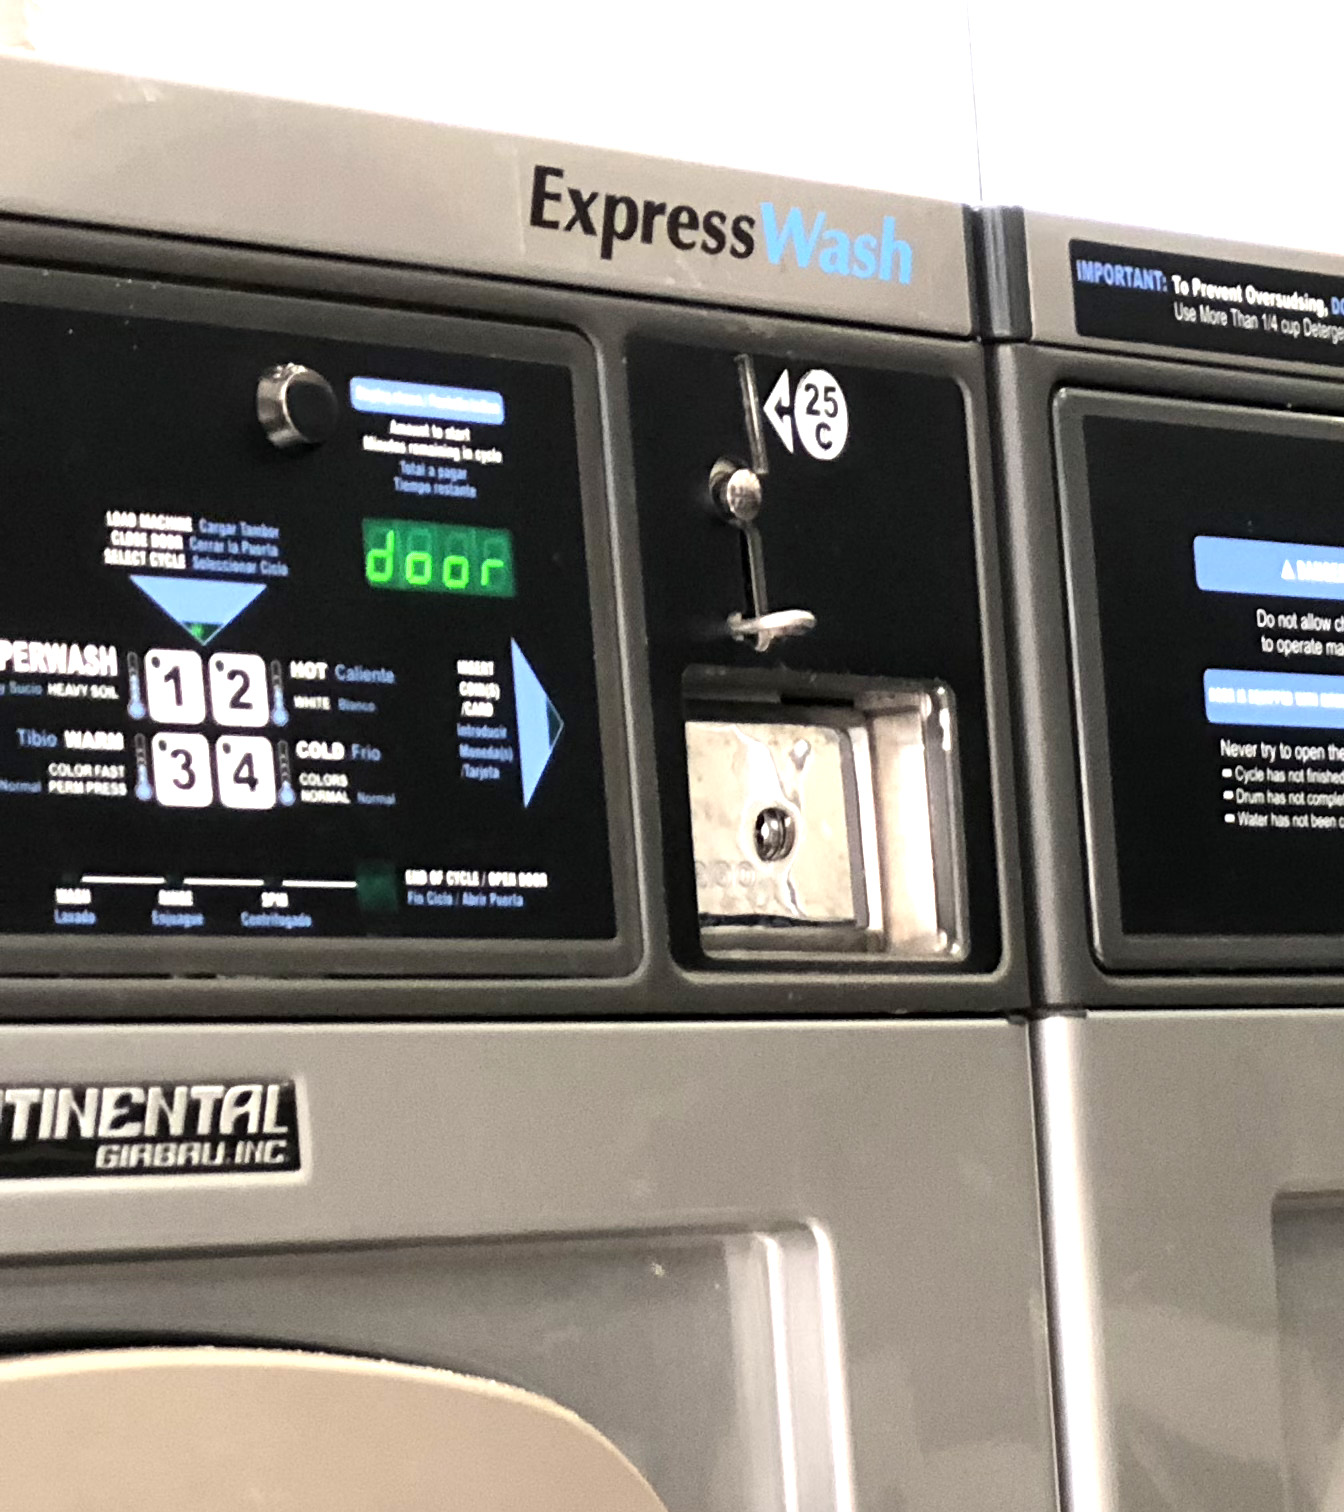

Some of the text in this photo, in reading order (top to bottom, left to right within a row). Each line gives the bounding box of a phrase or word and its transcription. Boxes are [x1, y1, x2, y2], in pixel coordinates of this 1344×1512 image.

[529, 164, 912, 285] ExpressWash
[1076, 259, 1168, 293] IMPORTANT:
[1171, 274, 1189, 296] To
[1191, 277, 1242, 304] Prevent
[1173, 301, 1197, 322] Use
[1200, 304, 1228, 327] More
[1230, 307, 1258, 330] Than
[1281, 317, 1300, 339] cup
[804, 383, 838, 418] 25
[815, 421, 833, 451] C
[149, 550, 187, 569] CYCLE
[365, 529, 505, 589] door
[1256, 608, 1276, 628] Do
[1277, 612, 1298, 630] not
[1300, 613, 1332, 631] allow
[1261, 634, 1275, 652] to
[1276, 638, 1324, 657] operate
[290, 660, 397, 685] HOT Caliente
[47, 682, 88, 699] HEAVY
[164, 665, 184, 707] 1
[226, 669, 253, 710] 2
[293, 695, 332, 712] WHITE
[16, 728, 126, 752] Tibio WARM
[295, 740, 346, 762] COLD
[1220, 738, 1258, 758] Never
[1260, 741, 1277, 763] try
[1279, 741, 1292, 759] to
[1294, 745, 1325, 765] open
[48, 762, 93, 777] COLOR
[170, 749, 196, 790] 3
[233, 752, 259, 793] 4
[299, 772, 348, 788] COLORS
[1234, 764, 1265, 785] Cycle
[1266, 767, 1286, 783] has
[1288, 768, 1305, 784] not
[1235, 787, 1265, 805] Drum
[1266, 789, 1286, 805] has
[1289, 790, 1306, 806] not
[1237, 811, 1268, 829] Water
[1270, 812, 1290, 829] has
[1292, 813, 1309, 829] not
[1310, 813, 1337, 830] been
[0, 1084, 288, 1141] TINENTAL
